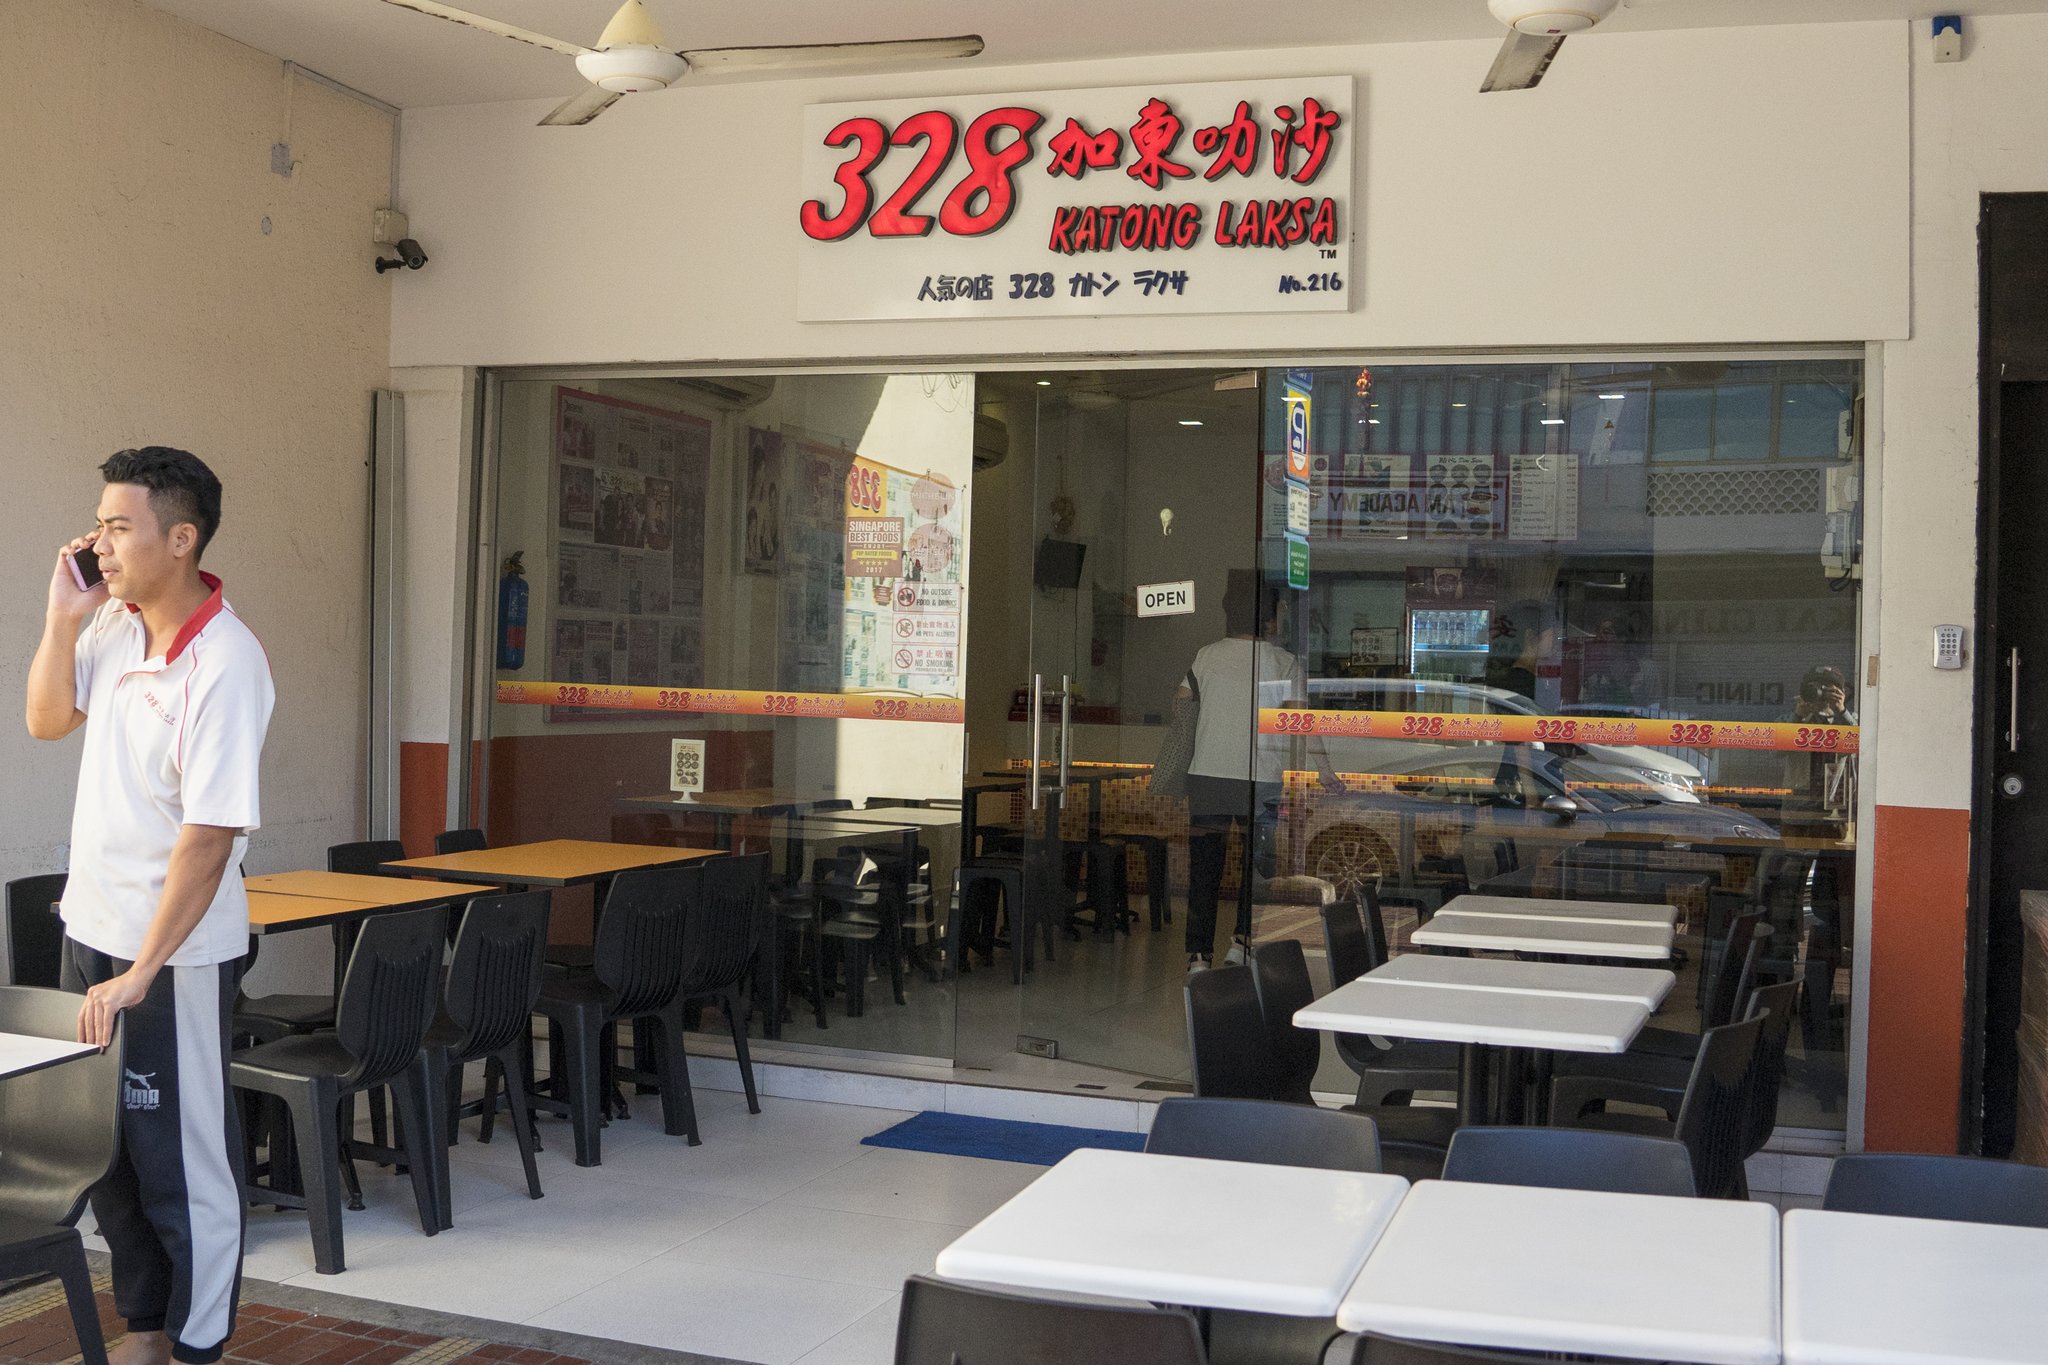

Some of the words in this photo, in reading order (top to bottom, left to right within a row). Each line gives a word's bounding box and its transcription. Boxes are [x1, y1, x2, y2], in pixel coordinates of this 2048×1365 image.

[800, 106, 1046, 241] 328
[1047, 97, 1341, 191] 加東叻沙
[1048, 202, 1201, 256] KATONG
[1214, 197, 1338, 250] LAKSA
[1319, 250, 1337, 259] TM
[917, 274, 994, 302] 人気の店
[1008, 273, 1055, 299] 328
[1069, 272, 1120, 298] カトン
[1133, 269, 1189, 296] ラクサ
[1279, 272, 1342, 294] No.216
[849, 521, 901, 532] SINGAPORE
[850, 532, 870, 541] BEST
[872, 532, 899, 542] FOODS
[921, 588, 929, 596] NO
[930, 588, 953, 596] OUTSIDE
[1145, 590, 1186, 608] OPEN
[916, 598, 930, 606] FOOD
[938, 599, 957, 607] DRINKS
[915, 659, 923, 667] NO
[926, 659, 954, 668] SMOKING
[556, 685, 589, 704] 328
[657, 690, 691, 709] 328
[762, 694, 798, 713] 328
[871, 699, 909, 718] 328
[1274, 712, 1316, 733] 328
[1402, 715, 1445, 737] 328
[1533, 719, 1577, 740] 328
[1580, 733, 1611, 741] KATONG
[1612, 733, 1639, 742] LAKSA
[1668, 723, 1714, 744] 328
[1717, 737, 1749, 746] KATONG
[1750, 738, 1775, 747] LAKSA
[1793, 727, 1840, 749] 328
